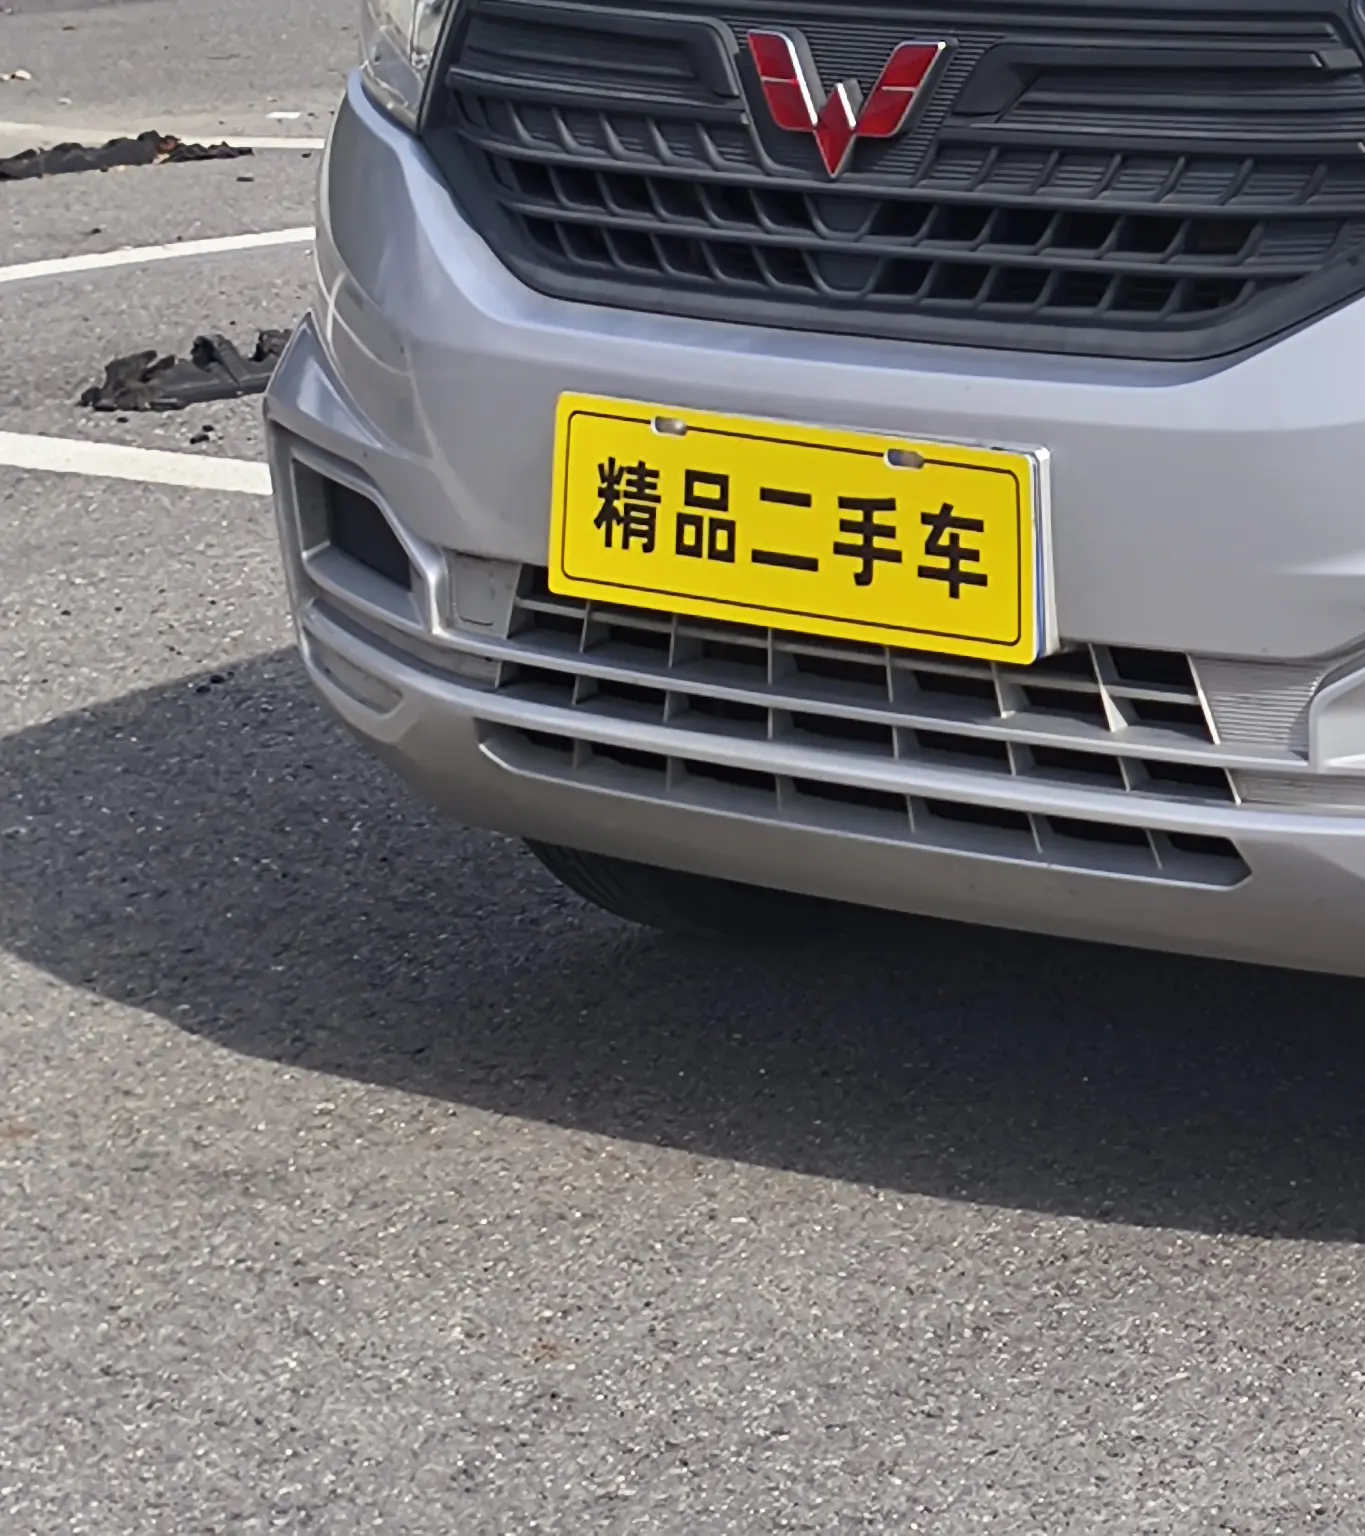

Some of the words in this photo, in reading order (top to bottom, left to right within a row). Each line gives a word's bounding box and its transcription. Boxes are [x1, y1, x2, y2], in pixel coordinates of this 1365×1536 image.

[593, 455, 989, 600] 精品二手车
